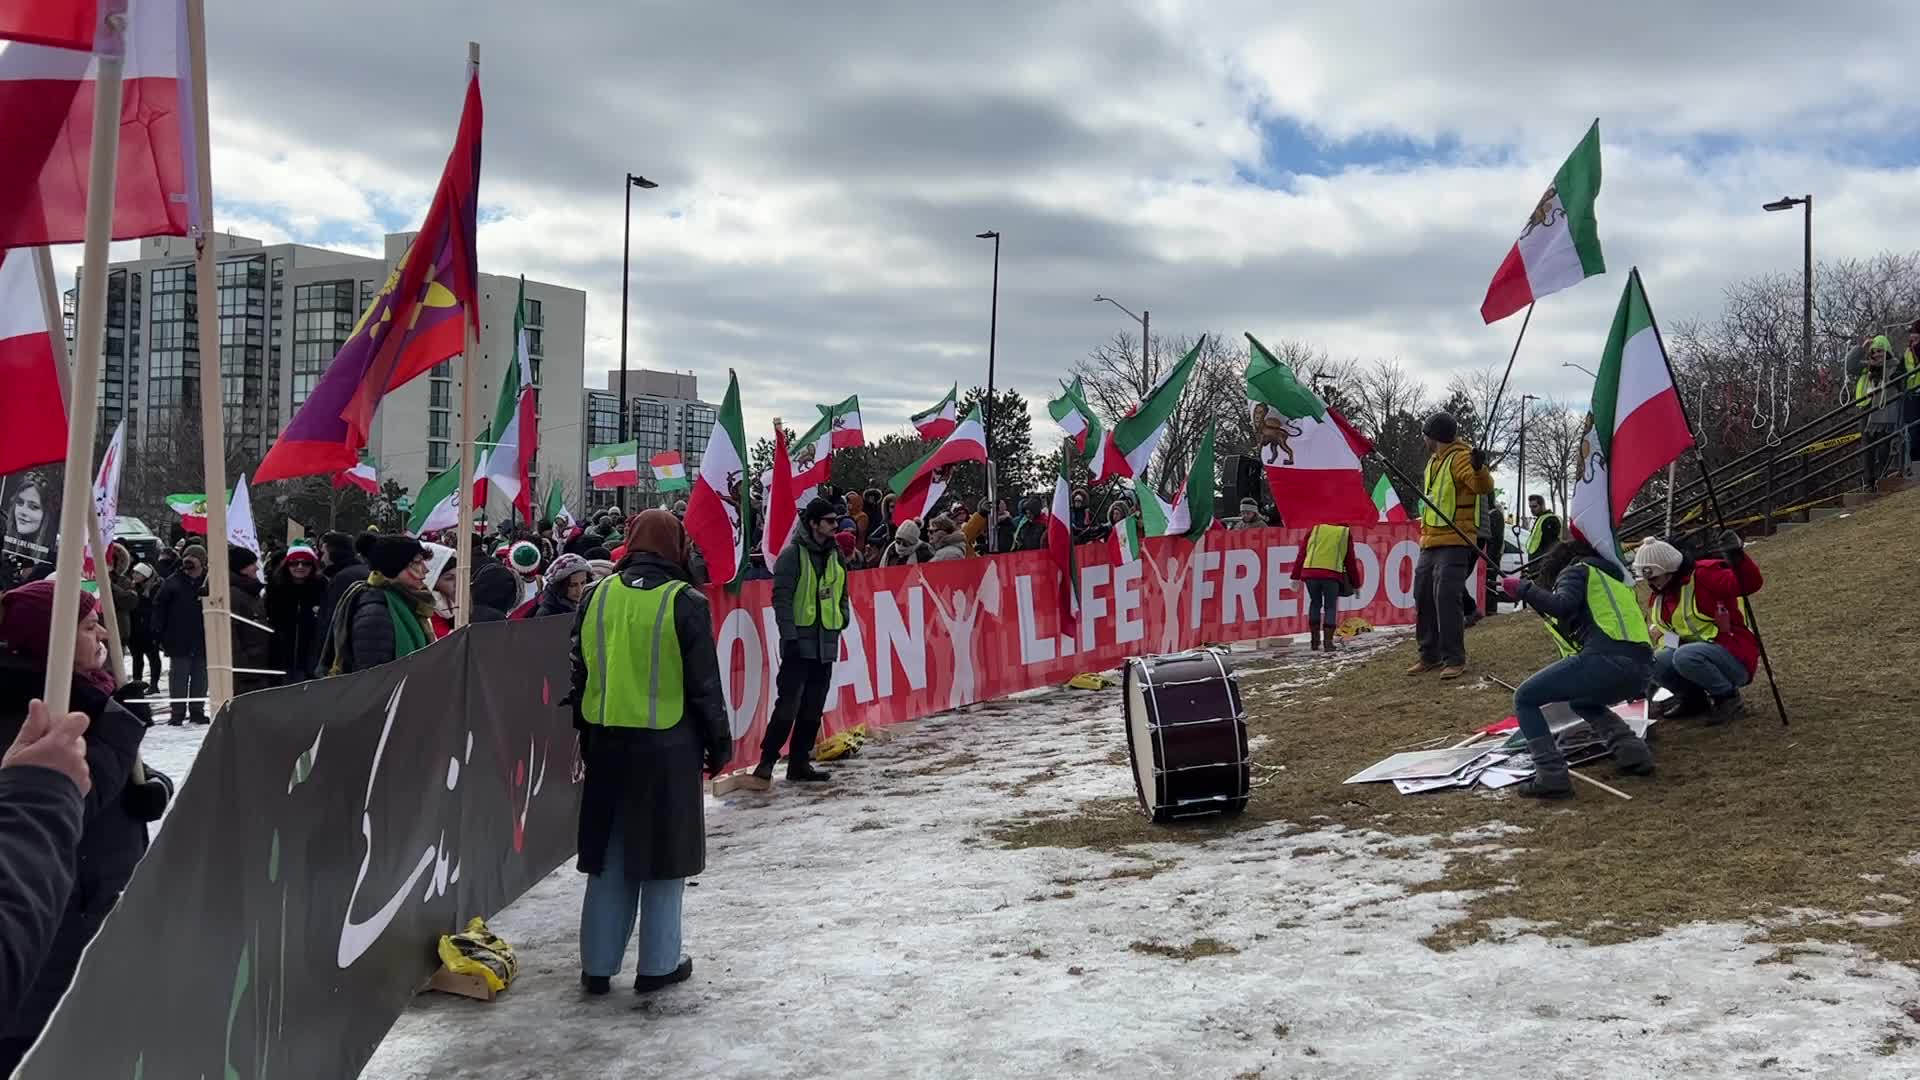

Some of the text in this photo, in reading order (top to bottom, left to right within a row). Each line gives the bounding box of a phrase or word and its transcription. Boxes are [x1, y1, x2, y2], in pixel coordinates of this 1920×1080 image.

[717, 540, 1482, 741] OAN LFE FREDO
